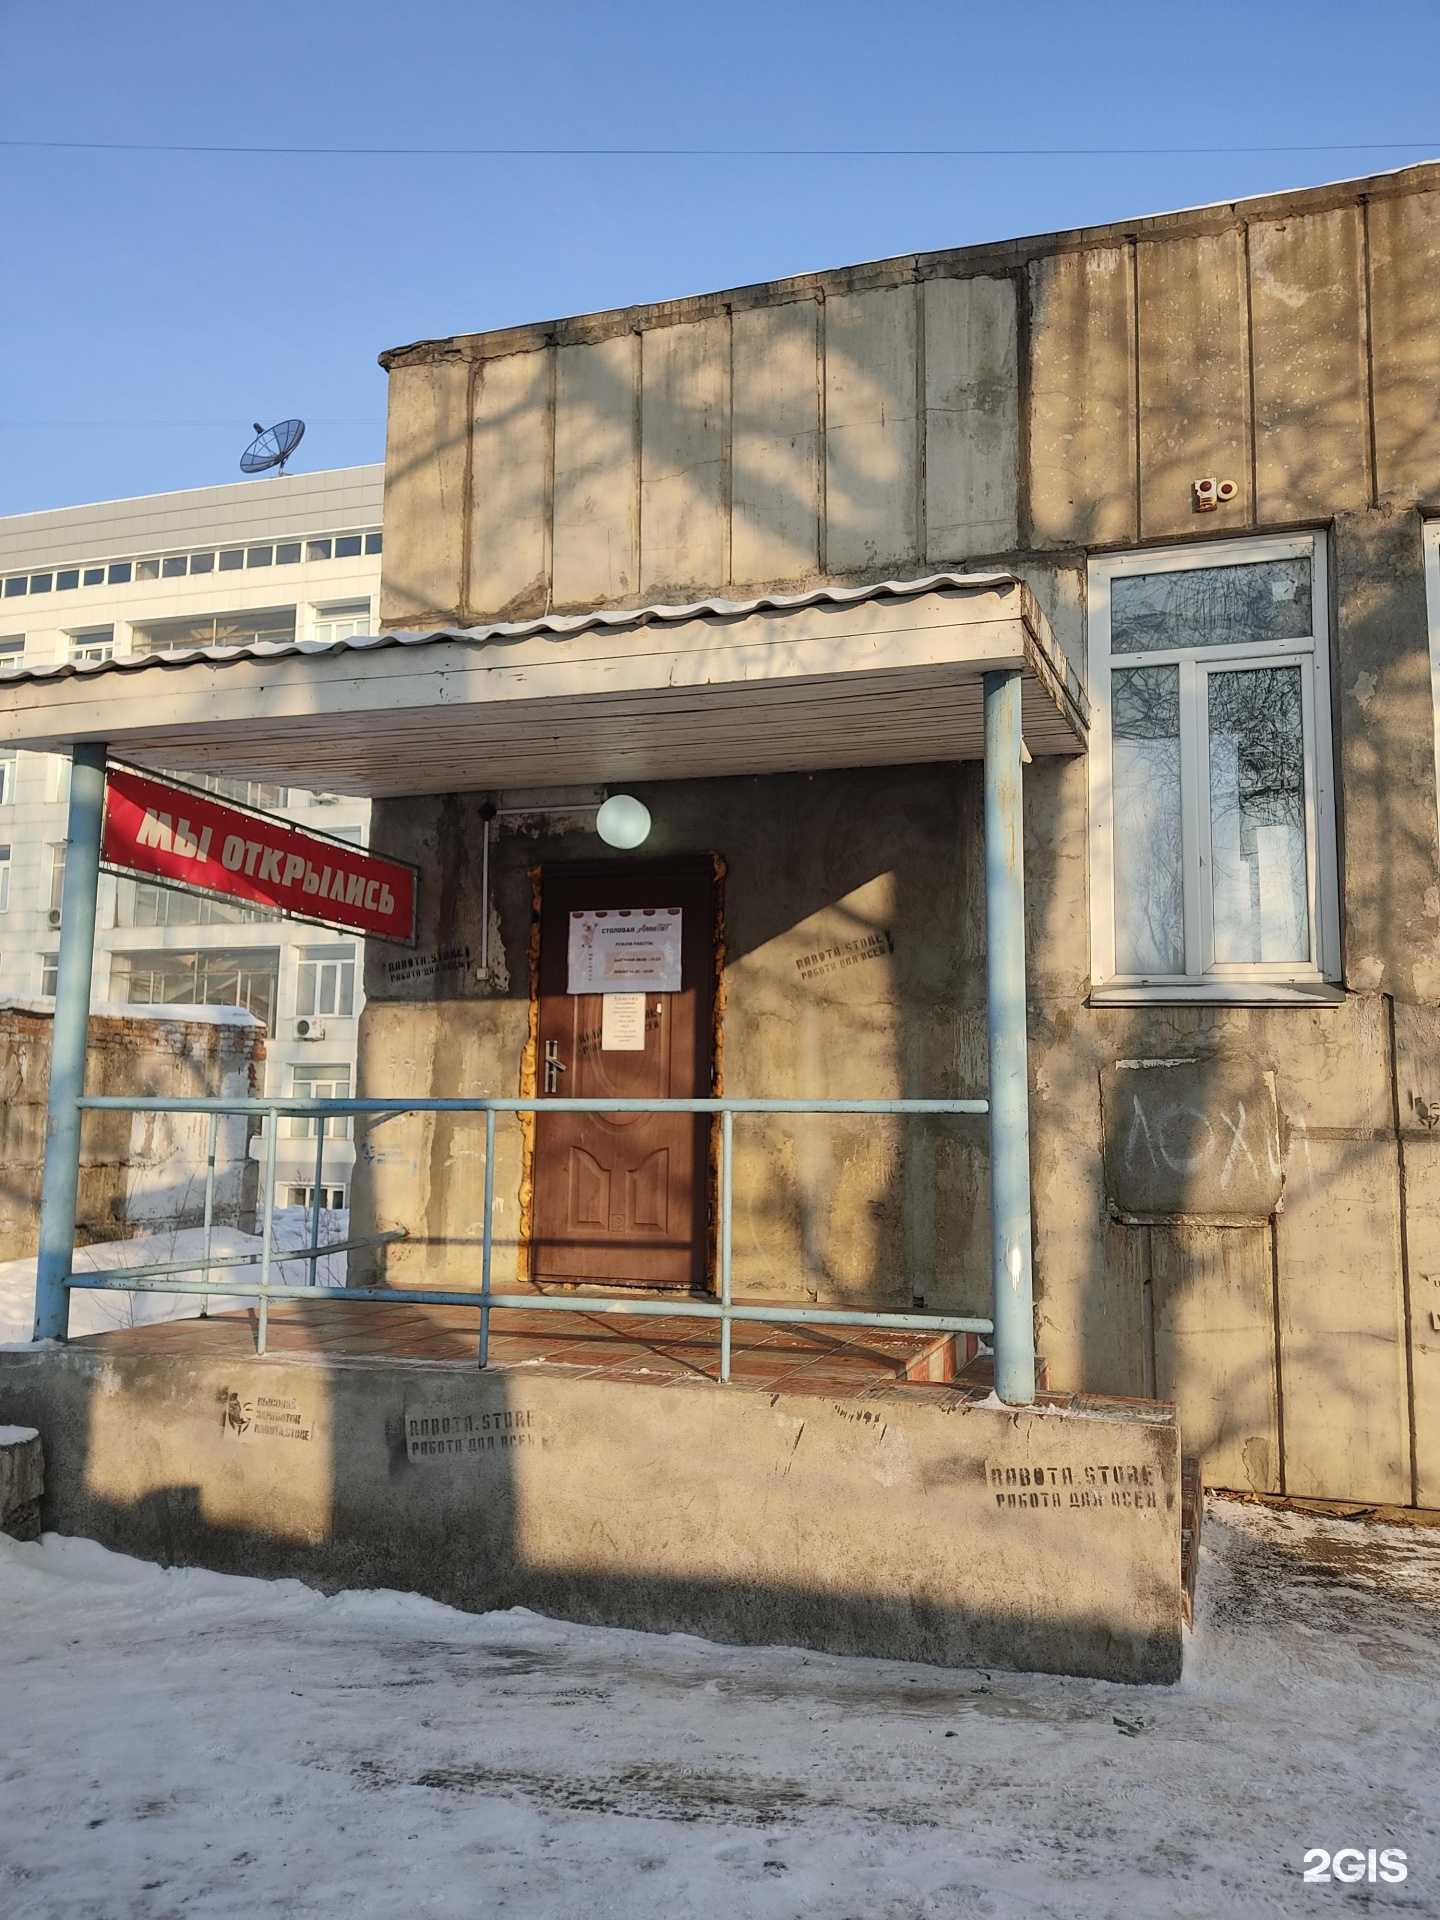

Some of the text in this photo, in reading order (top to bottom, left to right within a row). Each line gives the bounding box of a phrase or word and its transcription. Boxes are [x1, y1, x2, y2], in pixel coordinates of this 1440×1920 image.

[135, 808, 394, 915] МЫ ОТКРЫЛИСЬ
[412, 1438, 463, 1456] РАБОТА
[995, 1491, 1061, 1509] РАБОТА
